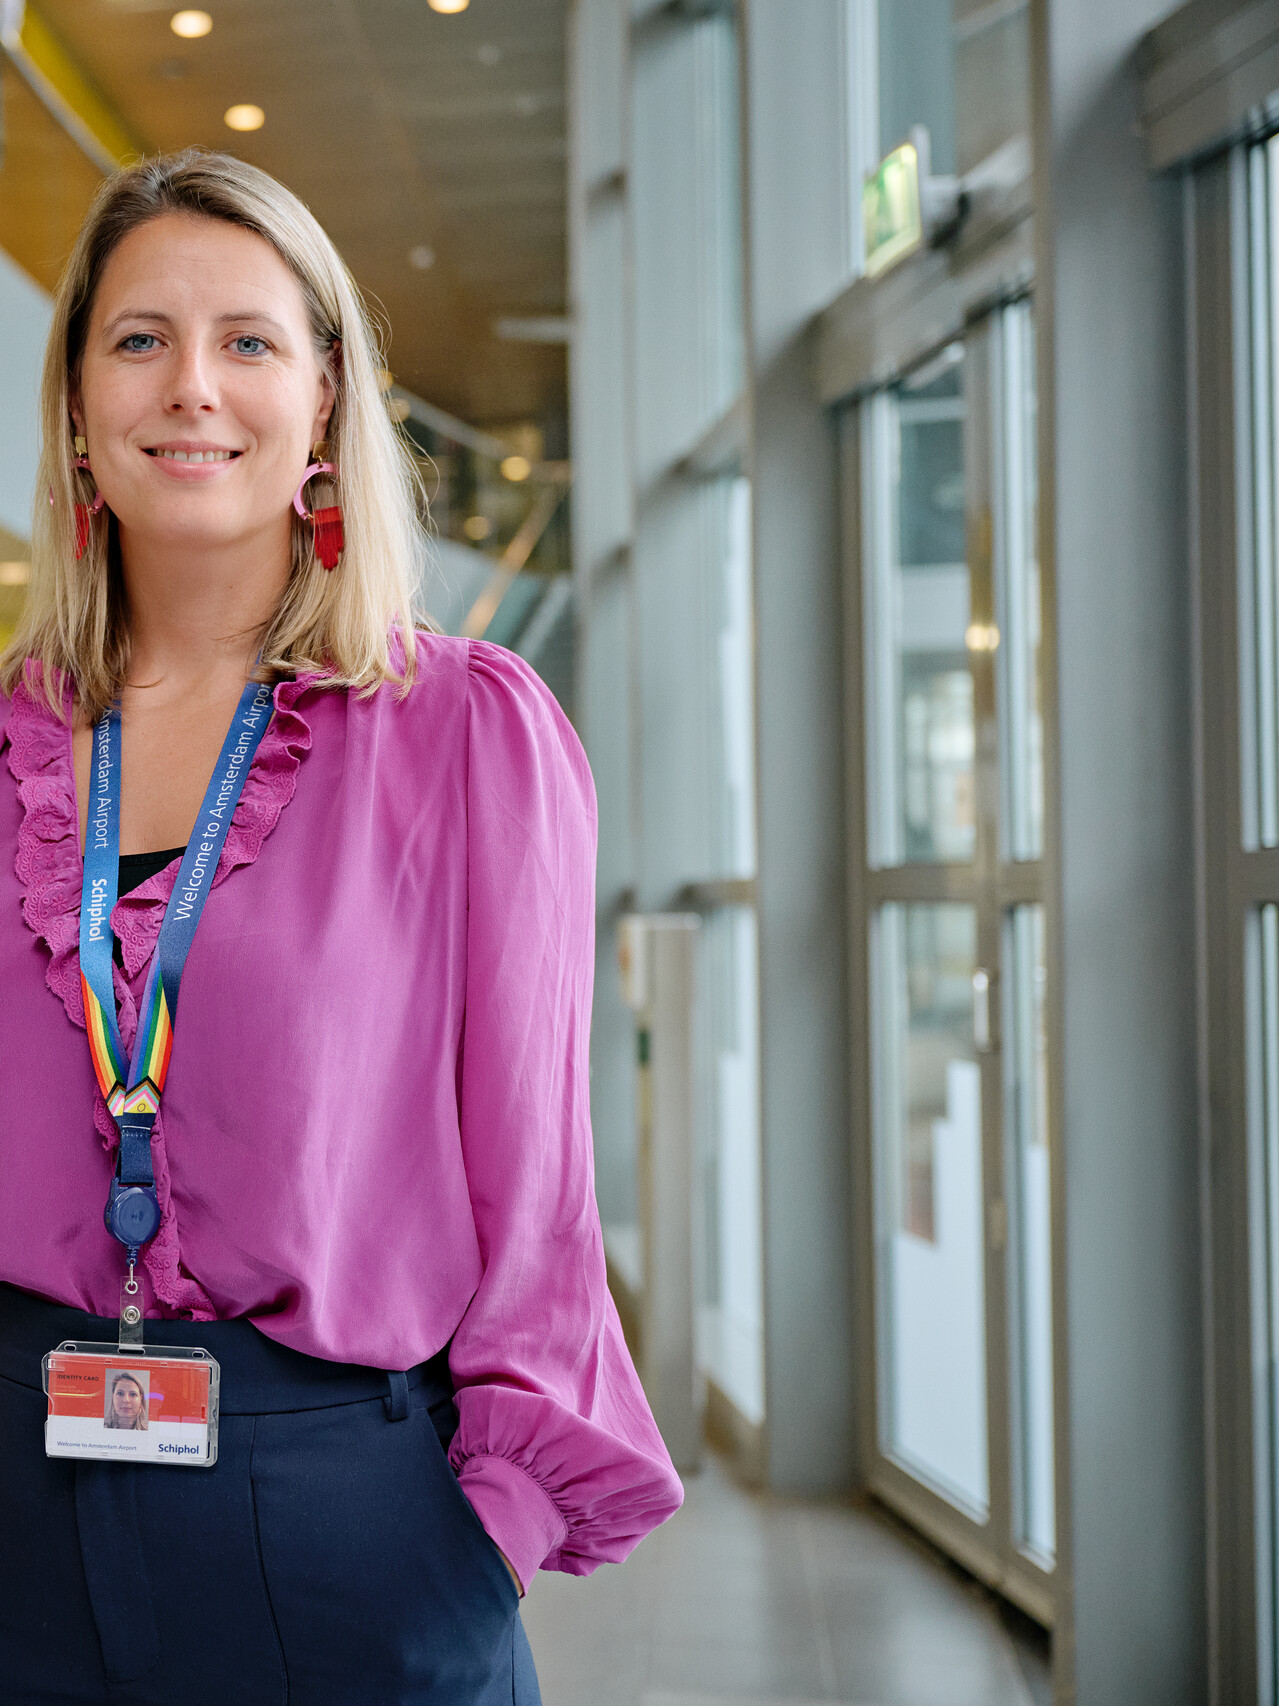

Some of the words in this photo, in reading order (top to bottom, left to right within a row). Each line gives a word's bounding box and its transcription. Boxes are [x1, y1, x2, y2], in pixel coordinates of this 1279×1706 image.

[242, 683, 271, 729] Airpor
[209, 731, 254, 819] Amsterdam
[92, 797, 112, 849] Airport
[202, 822, 220, 839] to
[173, 841, 214, 921] Welcome
[88, 878, 108, 942] Schiphol
[158, 1444, 199, 1455] Schiphol
